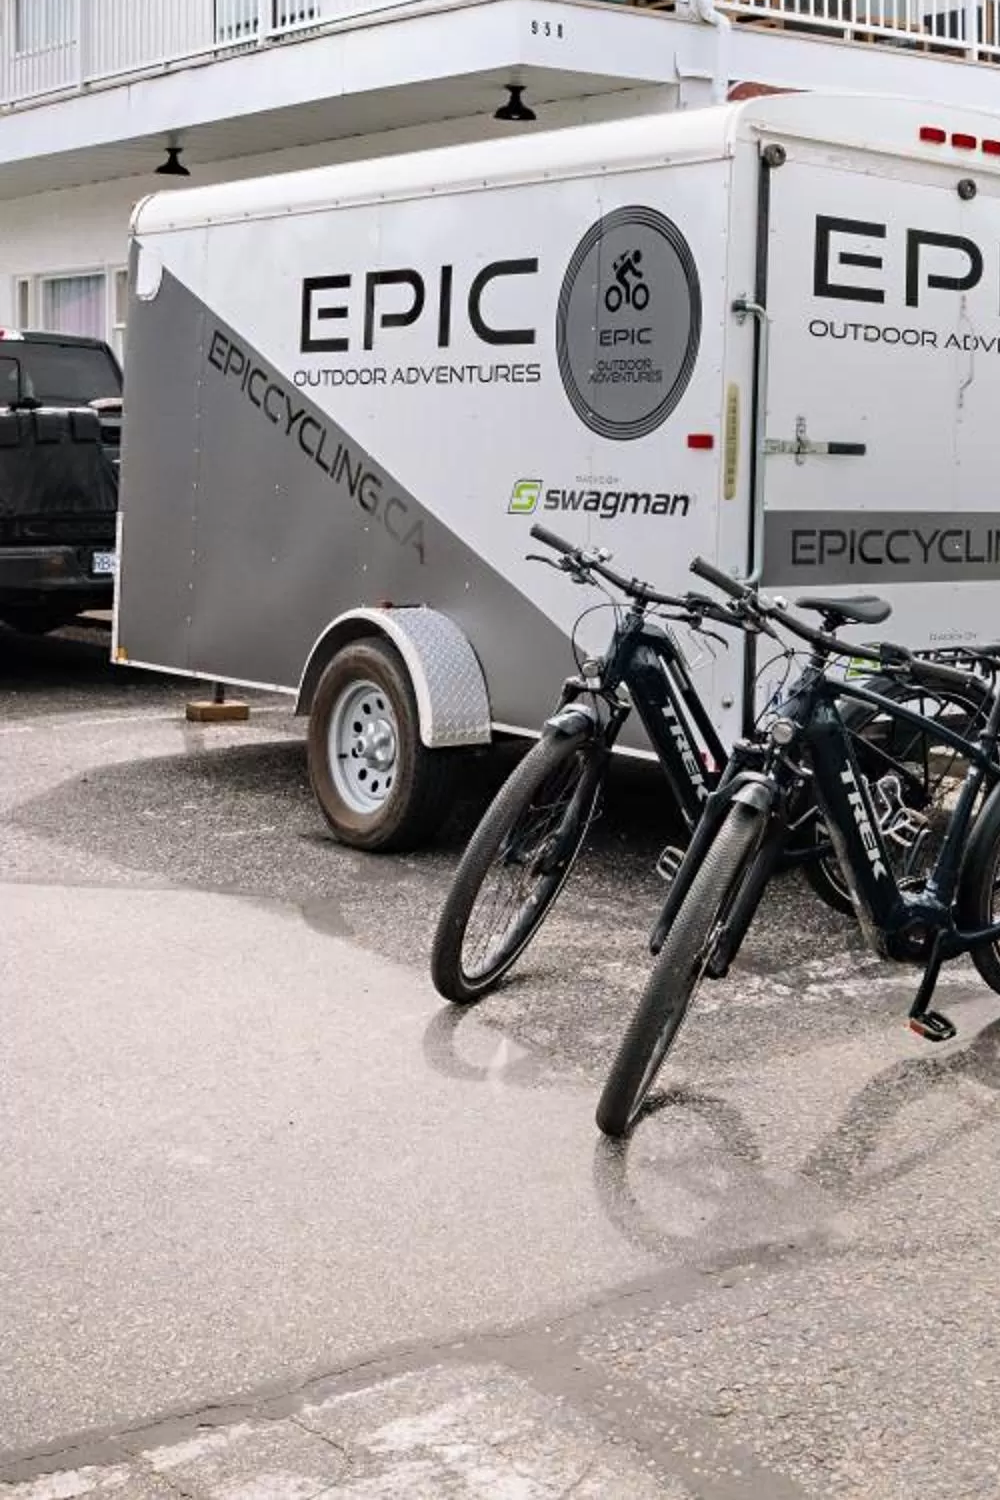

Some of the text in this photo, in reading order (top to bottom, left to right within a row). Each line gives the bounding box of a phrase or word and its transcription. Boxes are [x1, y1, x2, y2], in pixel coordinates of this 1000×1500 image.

[299, 257, 539, 354] EPIC
[599, 327, 653, 347] EPIC
[808, 318, 938, 350] OUTDOOR
[293, 363, 542, 387] OUTDOOR ADVENTURES
[595, 358, 653, 371] OUTDOOR
[207, 329, 425, 565] EPICCYCLING.CA
[544, 488, 690, 519] swagman
[661, 696, 709, 801] TREK
[841, 758, 888, 882] TREK
